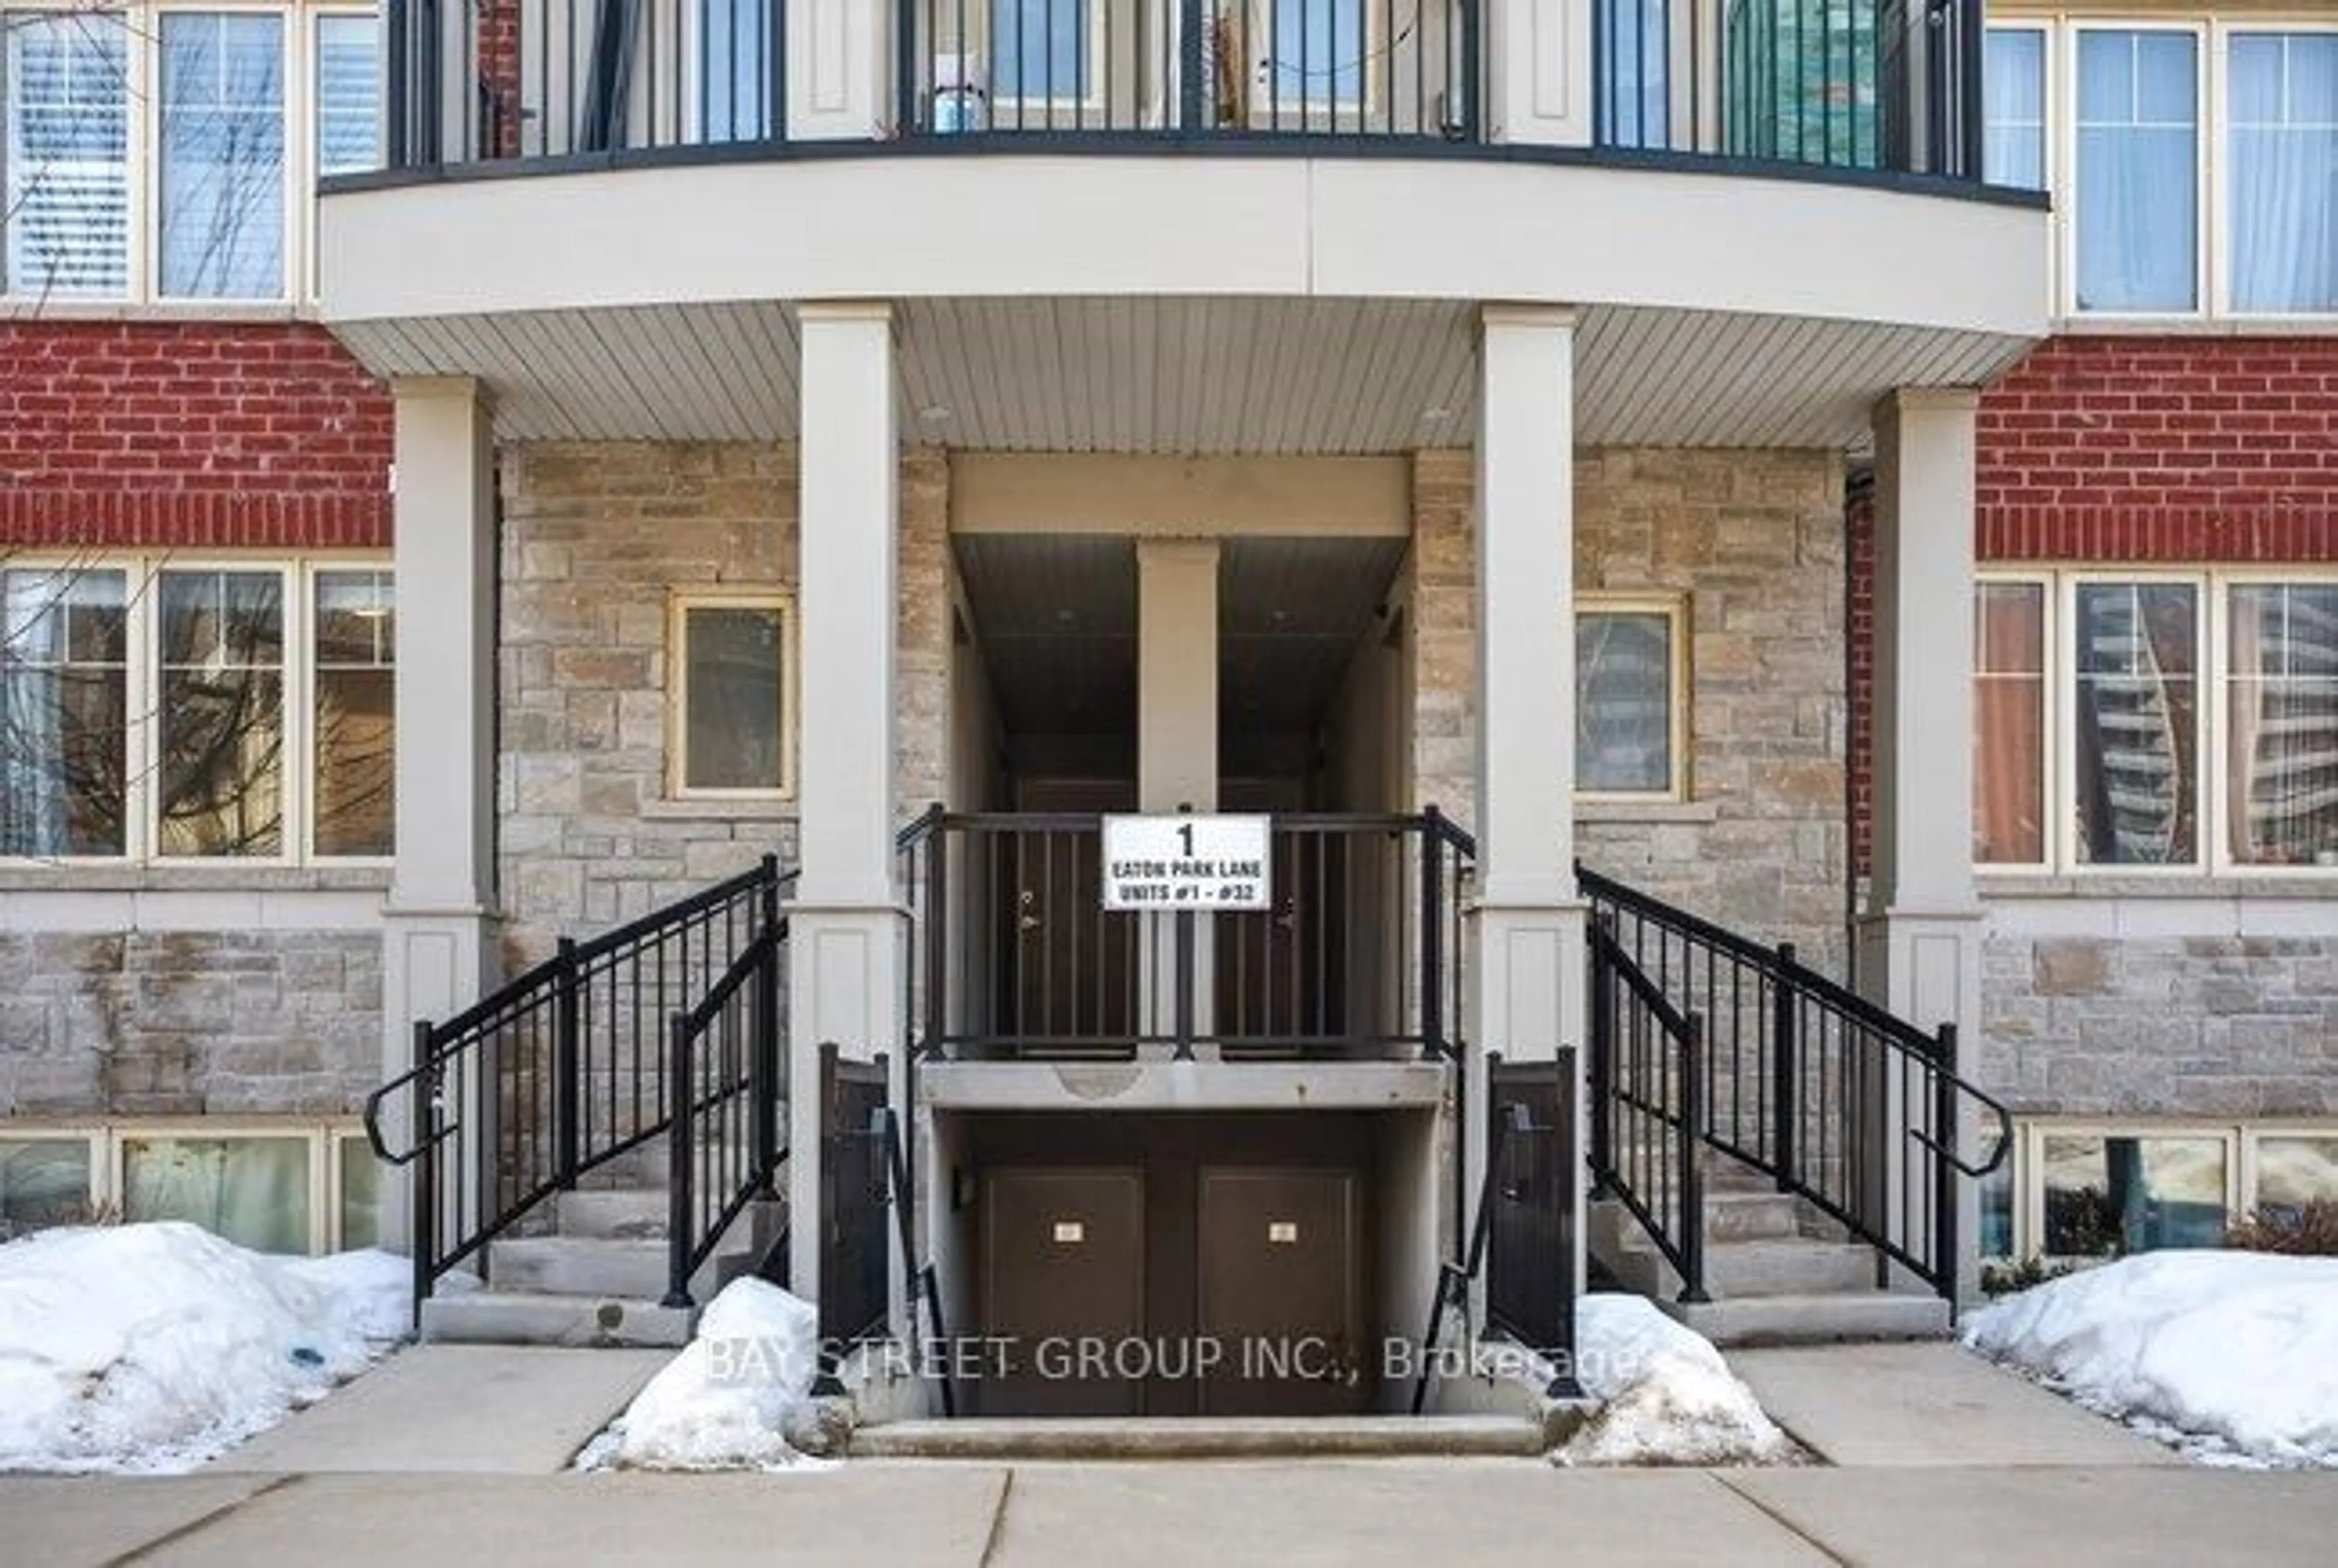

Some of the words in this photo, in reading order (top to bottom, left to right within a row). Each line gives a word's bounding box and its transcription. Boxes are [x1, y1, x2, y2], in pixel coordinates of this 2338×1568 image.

[1176, 823, 1192, 856] 1
[1112, 861, 1165, 878] EATON
[1171, 861, 1213, 878] PARK
[1220, 861, 1260, 878] LANE
[1119, 884, 1170, 900] UNITS
[1175, 884, 1199, 900] #1
